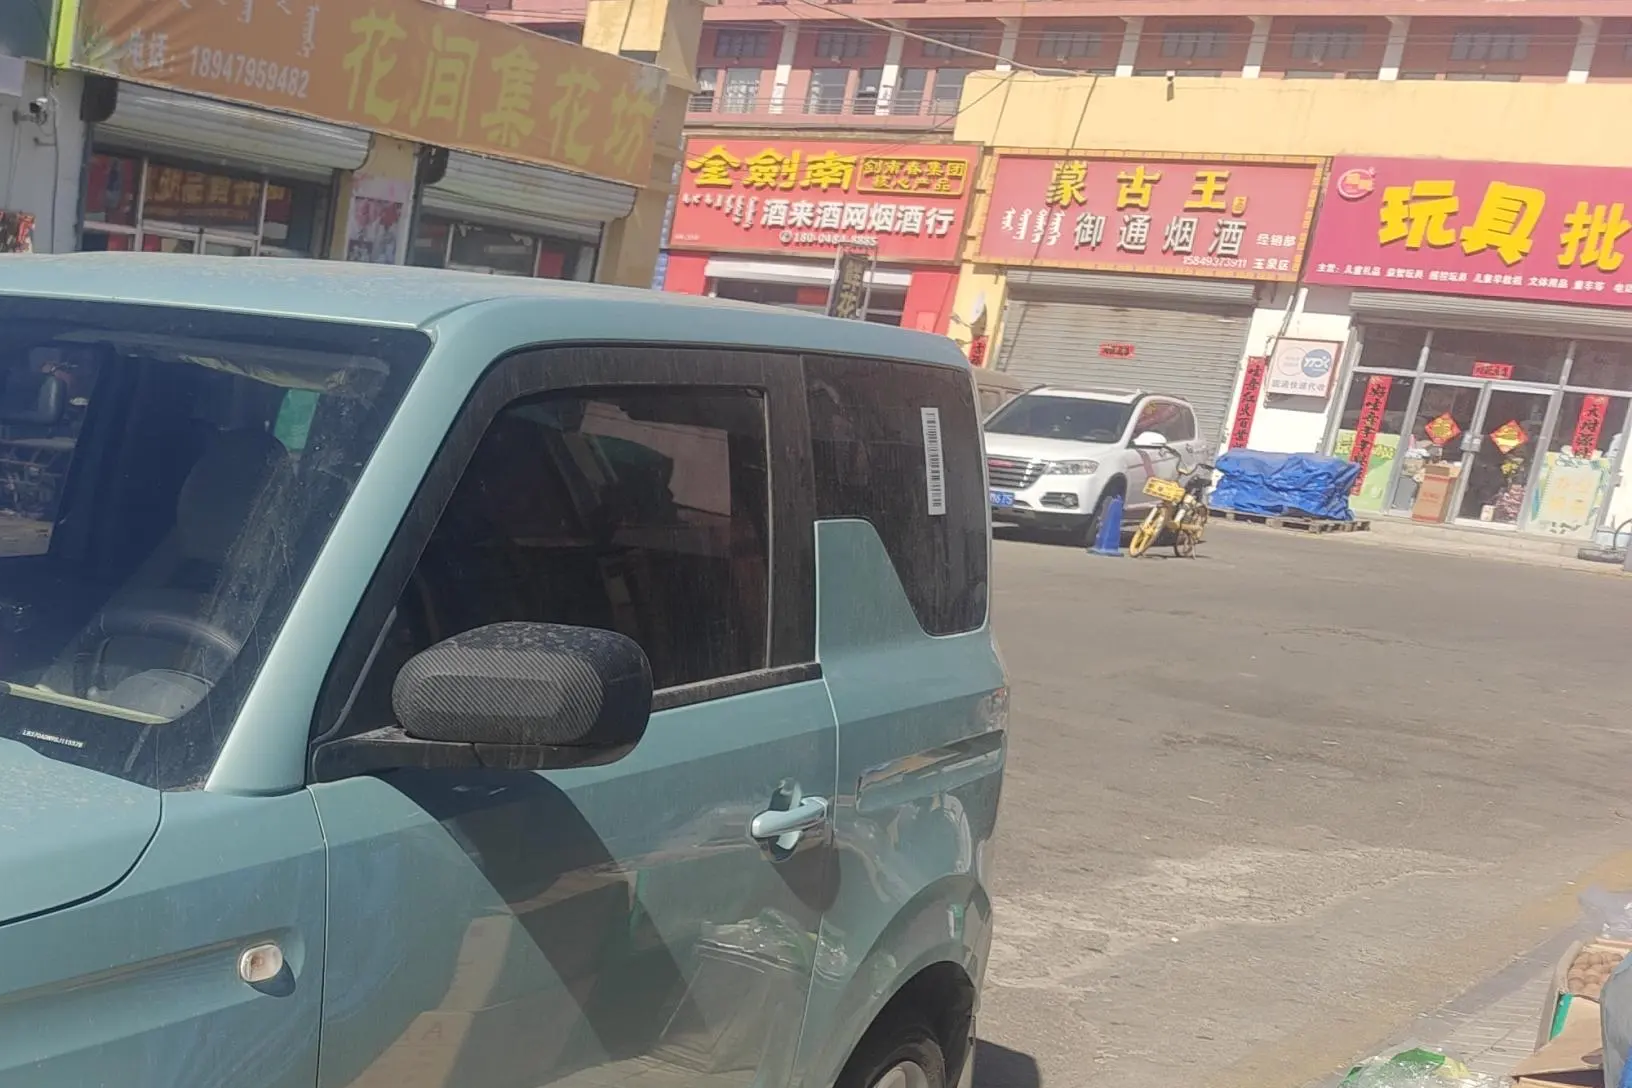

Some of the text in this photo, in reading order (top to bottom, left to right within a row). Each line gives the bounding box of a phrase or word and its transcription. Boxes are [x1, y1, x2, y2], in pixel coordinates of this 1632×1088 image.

[189, 45, 311, 99] 18947959482
[1045, 159, 1230, 211] 蒙古王
[760, 199, 954, 236] 酒来酒网烟酒行
[1074, 212, 1247, 257] 御通烟酒
[1378, 180, 1631, 271] 玩具批
